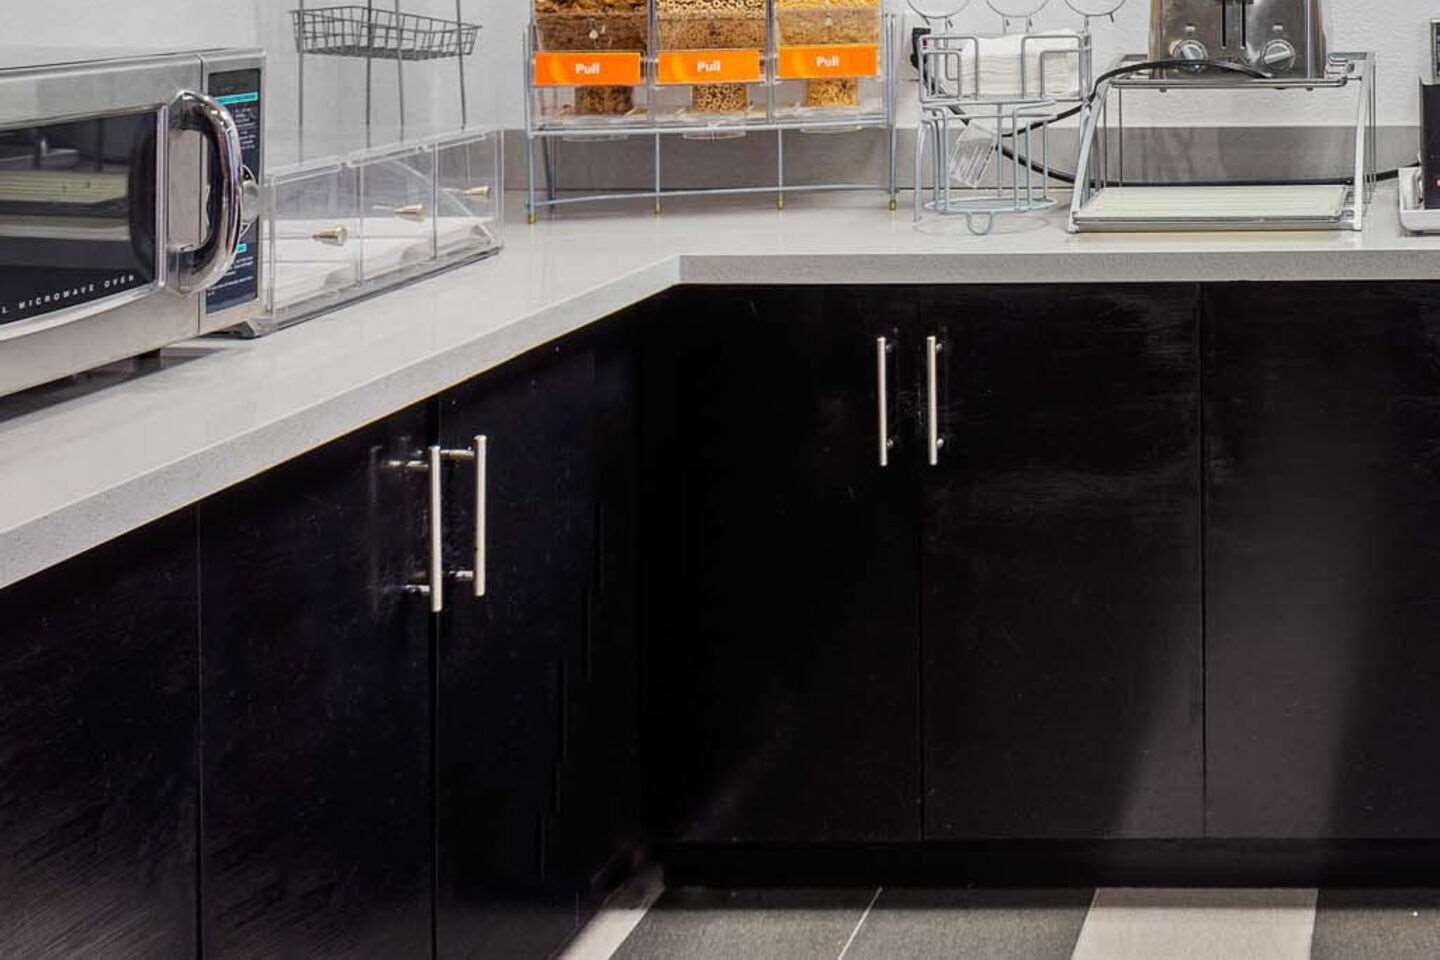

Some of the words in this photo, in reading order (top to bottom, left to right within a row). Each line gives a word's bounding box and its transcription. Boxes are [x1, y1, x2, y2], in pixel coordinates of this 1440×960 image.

[696, 59, 721, 72] Pull
[815, 55, 840, 67] Pull
[575, 63, 600, 74] Pull
[18, 283, 95, 310] MICROWAVE
[103, 274, 135, 288] OVEN
